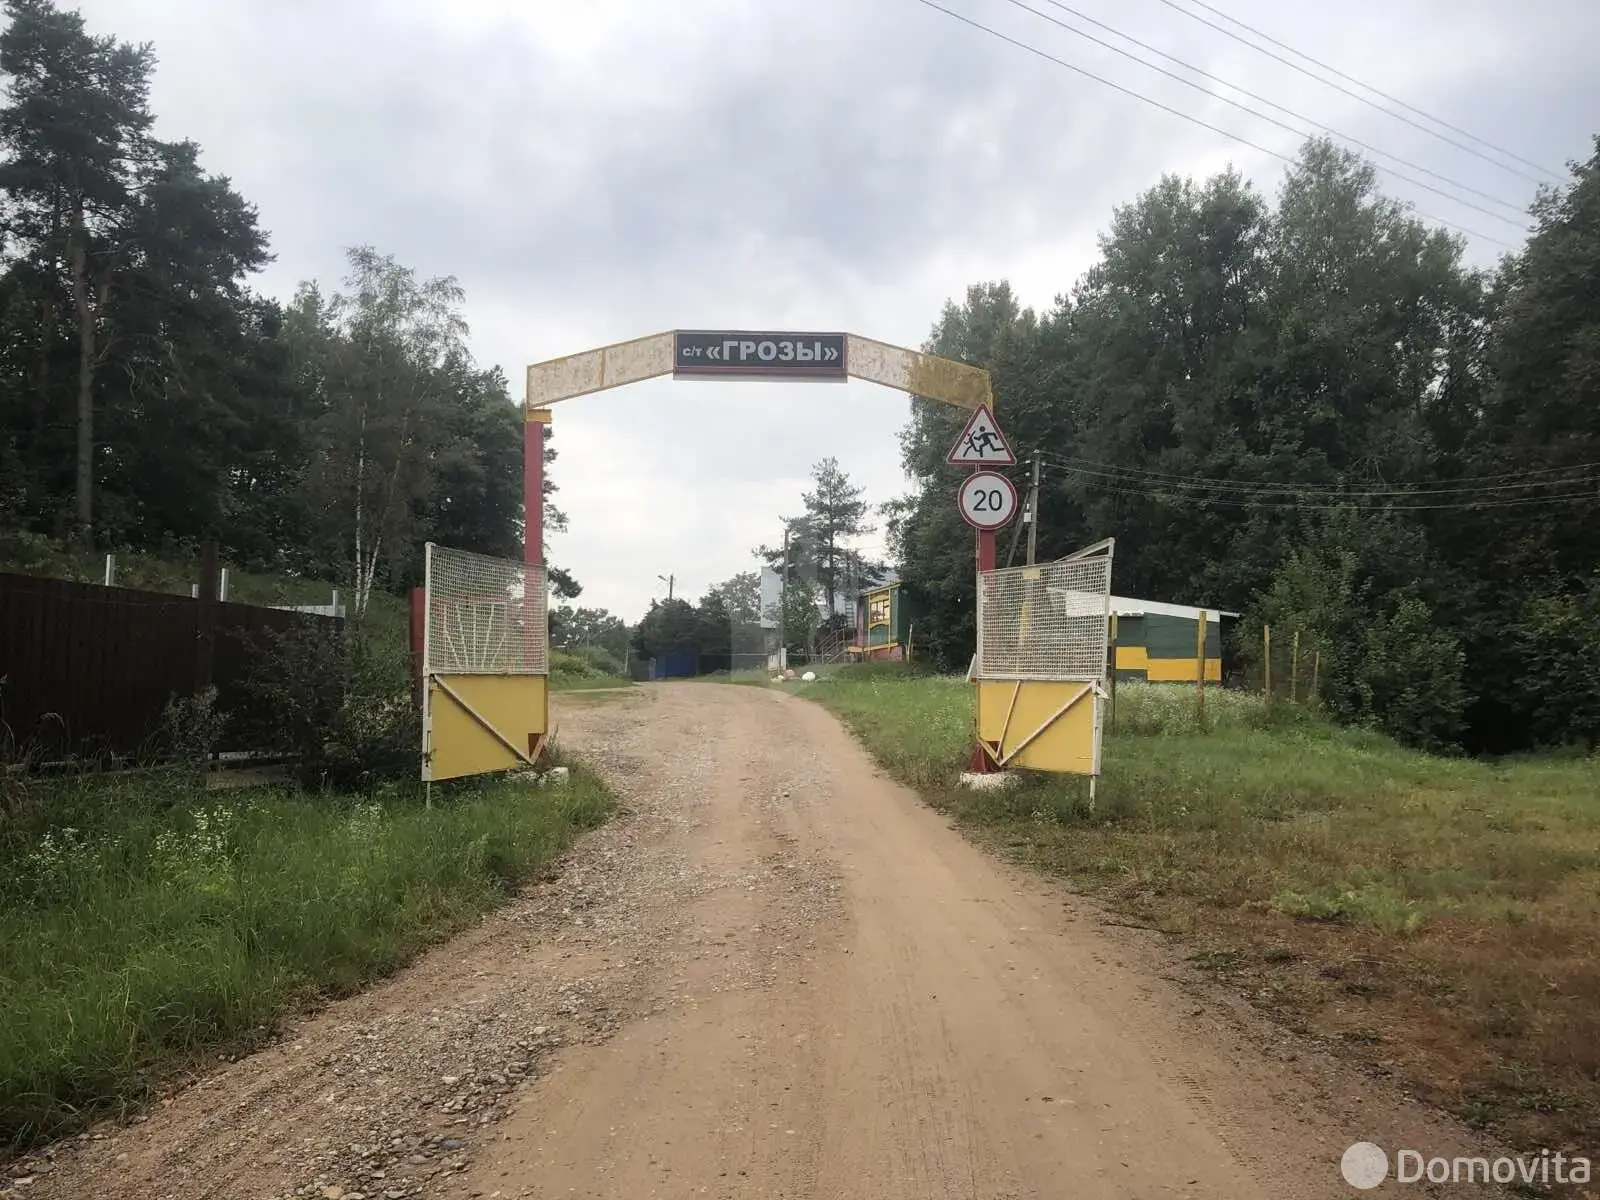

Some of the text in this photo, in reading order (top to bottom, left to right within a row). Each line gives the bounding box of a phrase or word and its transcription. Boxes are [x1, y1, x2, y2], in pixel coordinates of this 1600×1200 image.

[682, 341, 839, 361] с/т «ГРОЗЫ»
[973, 489, 1003, 511] 20
